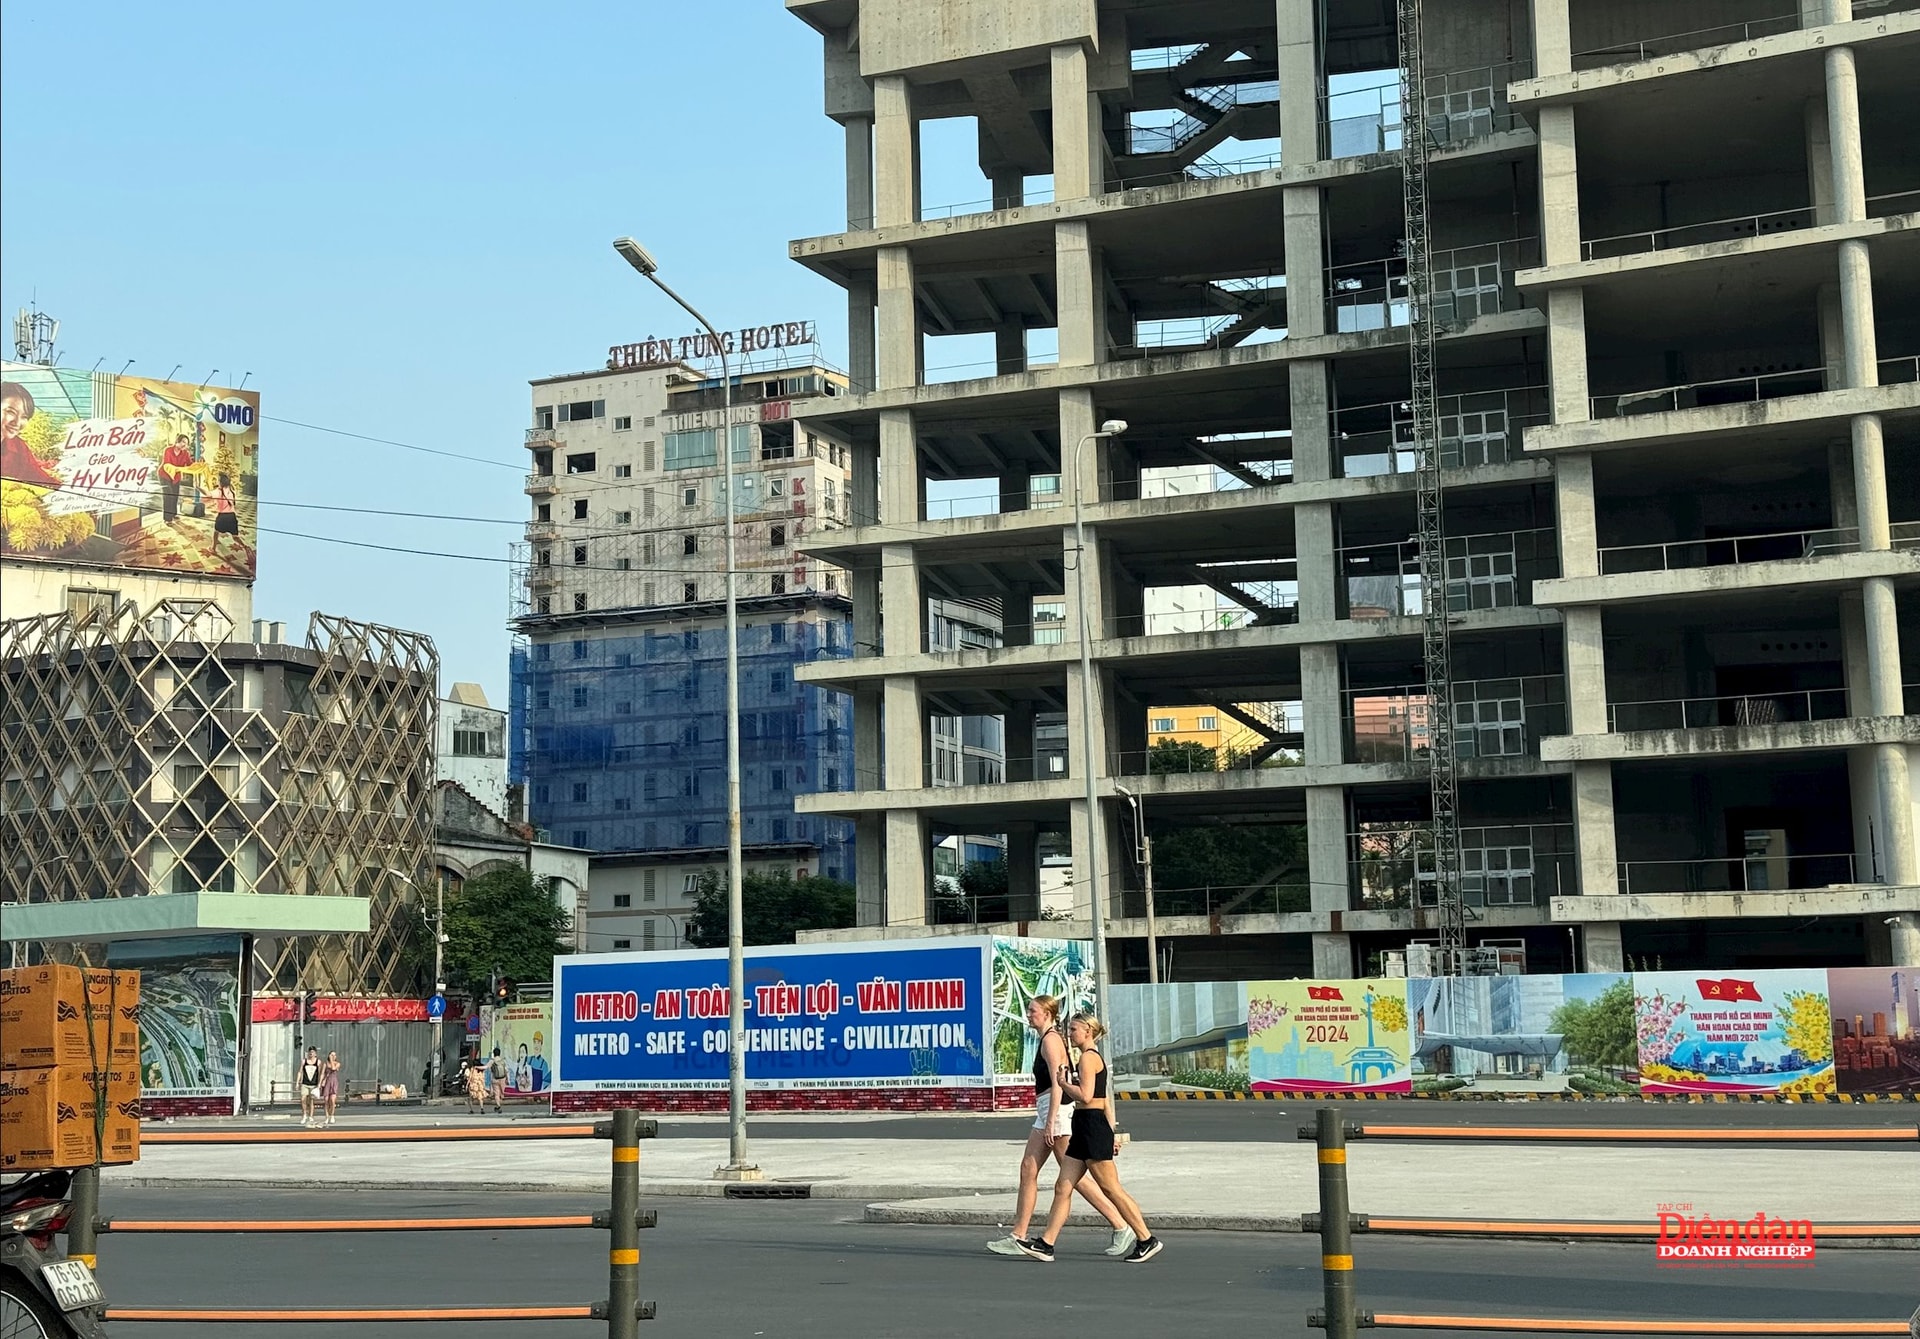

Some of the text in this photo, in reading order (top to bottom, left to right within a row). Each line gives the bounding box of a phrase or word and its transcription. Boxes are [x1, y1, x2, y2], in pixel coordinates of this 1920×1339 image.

[609, 321, 813, 367] THIÊN TÙNG HOTEL
[215, 403, 254, 426] OMO
[64, 418, 145, 449] Lấm Bẩn
[88, 453, 115, 466] Gieo
[70, 464, 149, 492] Hy Vọng
[575, 992, 637, 1021] METRO
[654, 988, 681, 1019] AN
[756, 981, 800, 1021] TIỆN
[806, 979, 838, 1020] LỢI
[858, 977, 900, 1013] VĂN
[907, 979, 965, 1012] MINH
[574, 1032, 630, 1056] METRO
[646, 1030, 686, 1055] SAFE
[703, 1027, 825, 1053] COVENIENCE
[843, 1024, 966, 1050] CIVILIZATION
[1306, 1025, 1349, 1042] 2024
[1740, 1034, 1759, 1042] 2024
